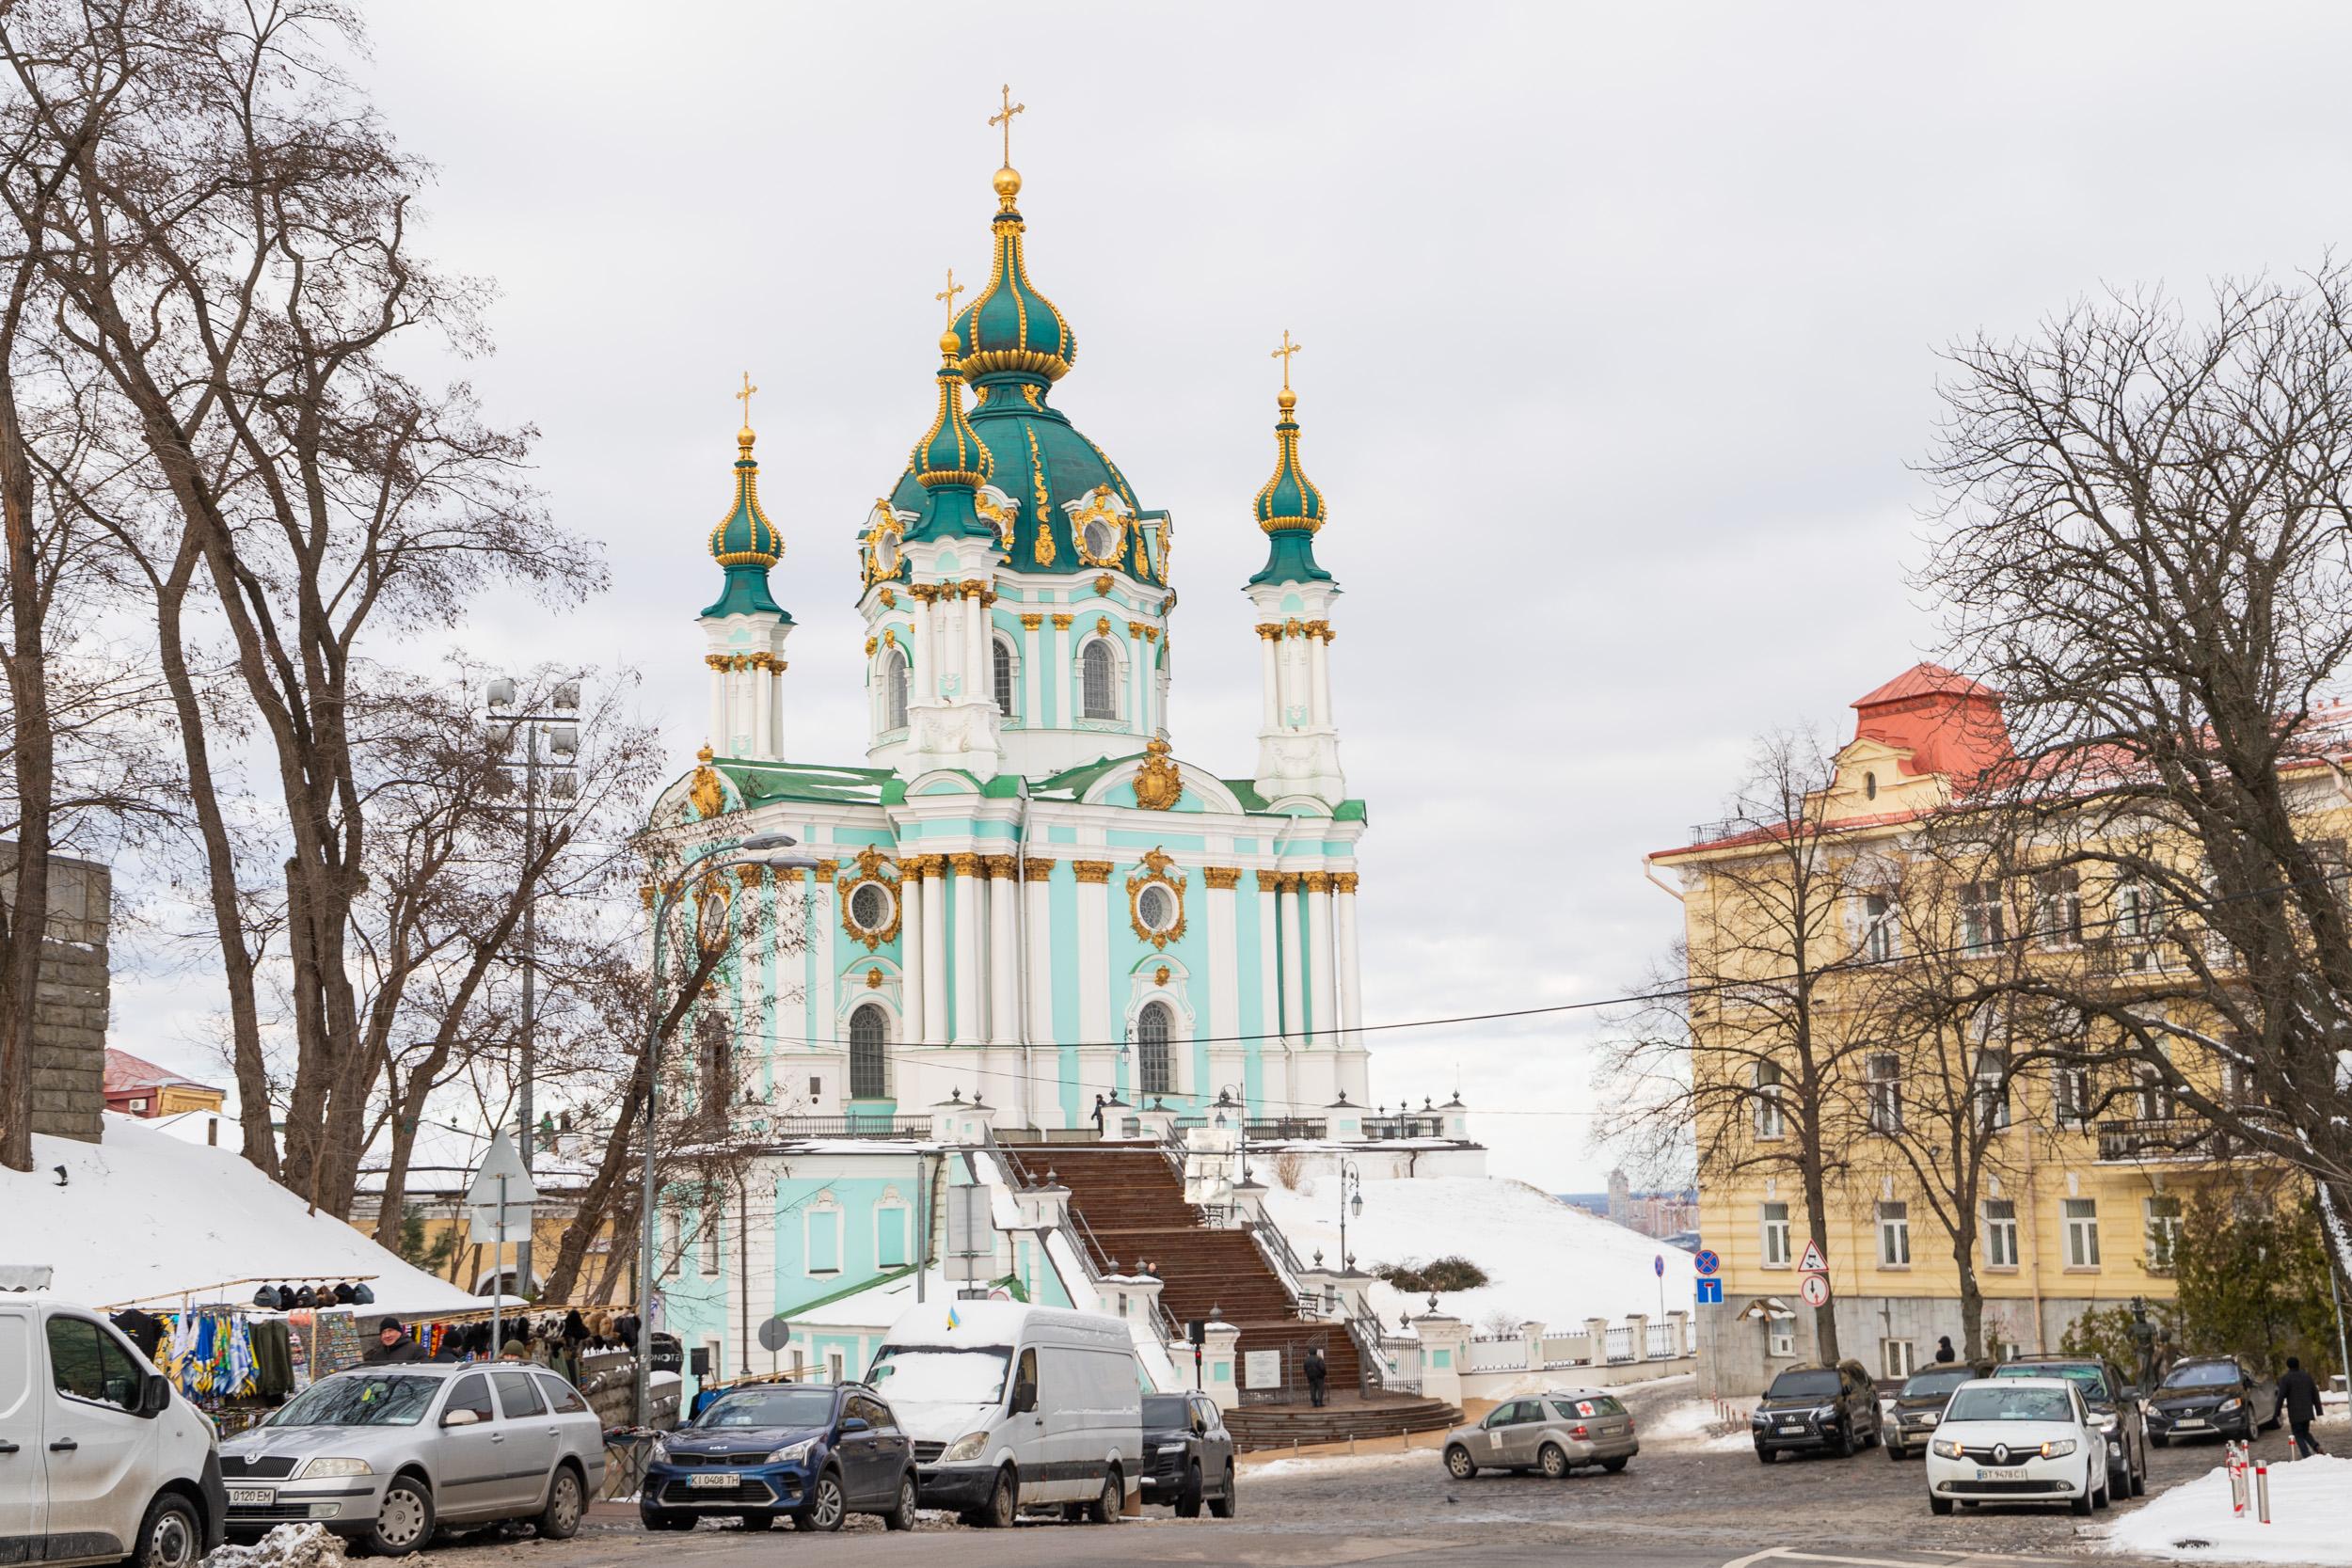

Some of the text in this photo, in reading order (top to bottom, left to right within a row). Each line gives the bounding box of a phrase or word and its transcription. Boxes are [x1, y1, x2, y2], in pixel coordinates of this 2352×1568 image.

[646, 1353, 684, 1363] ONOTEL
[691, 1475, 739, 1484] KI 0408 TH
[233, 1491, 256, 1501] 0120
[257, 1491, 271, 1502] EM
